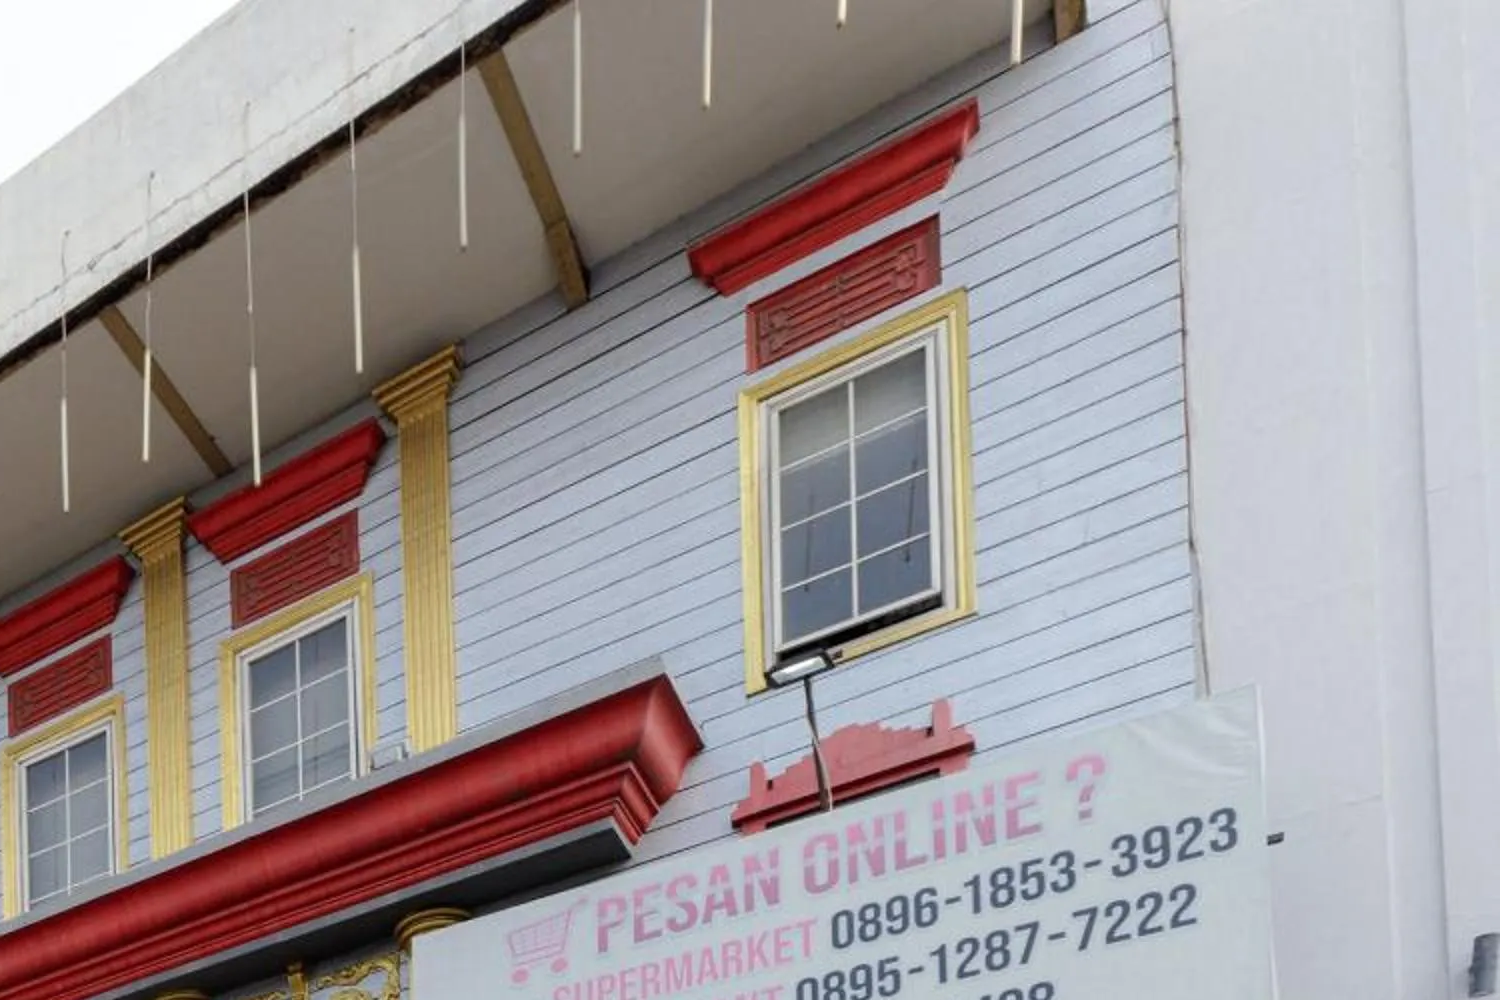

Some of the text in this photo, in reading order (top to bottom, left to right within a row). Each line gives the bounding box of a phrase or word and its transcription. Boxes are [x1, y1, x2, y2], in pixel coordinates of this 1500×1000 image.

[596, 848, 781, 953] PESAN
[803, 771, 1043, 895] ONLINE
[831, 807, 1238, 950] 0896-1853-3923
